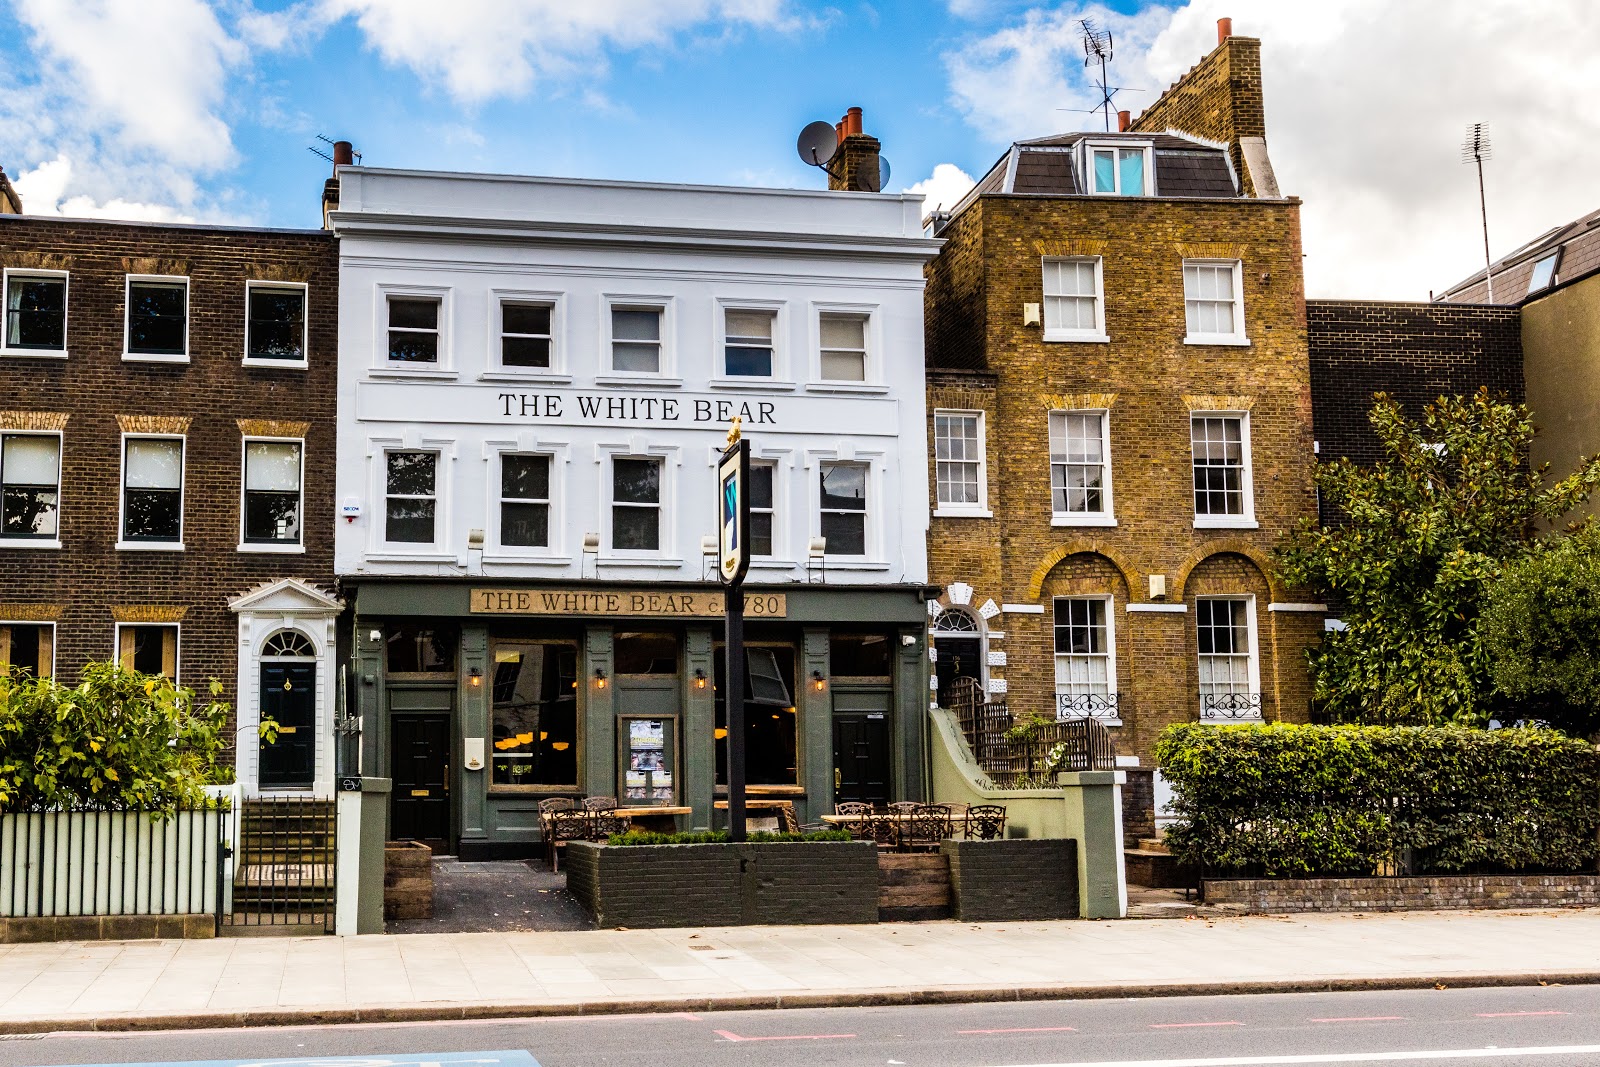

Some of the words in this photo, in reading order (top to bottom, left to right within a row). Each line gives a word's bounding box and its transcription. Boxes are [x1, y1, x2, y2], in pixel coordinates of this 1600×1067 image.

[499, 393, 563, 417] THE
[576, 396, 680, 421] WHITE
[693, 399, 777, 424] BEAR
[481, 592, 531, 610] THE
[541, 593, 620, 612] WHITE
[630, 595, 695, 613] BEAR
